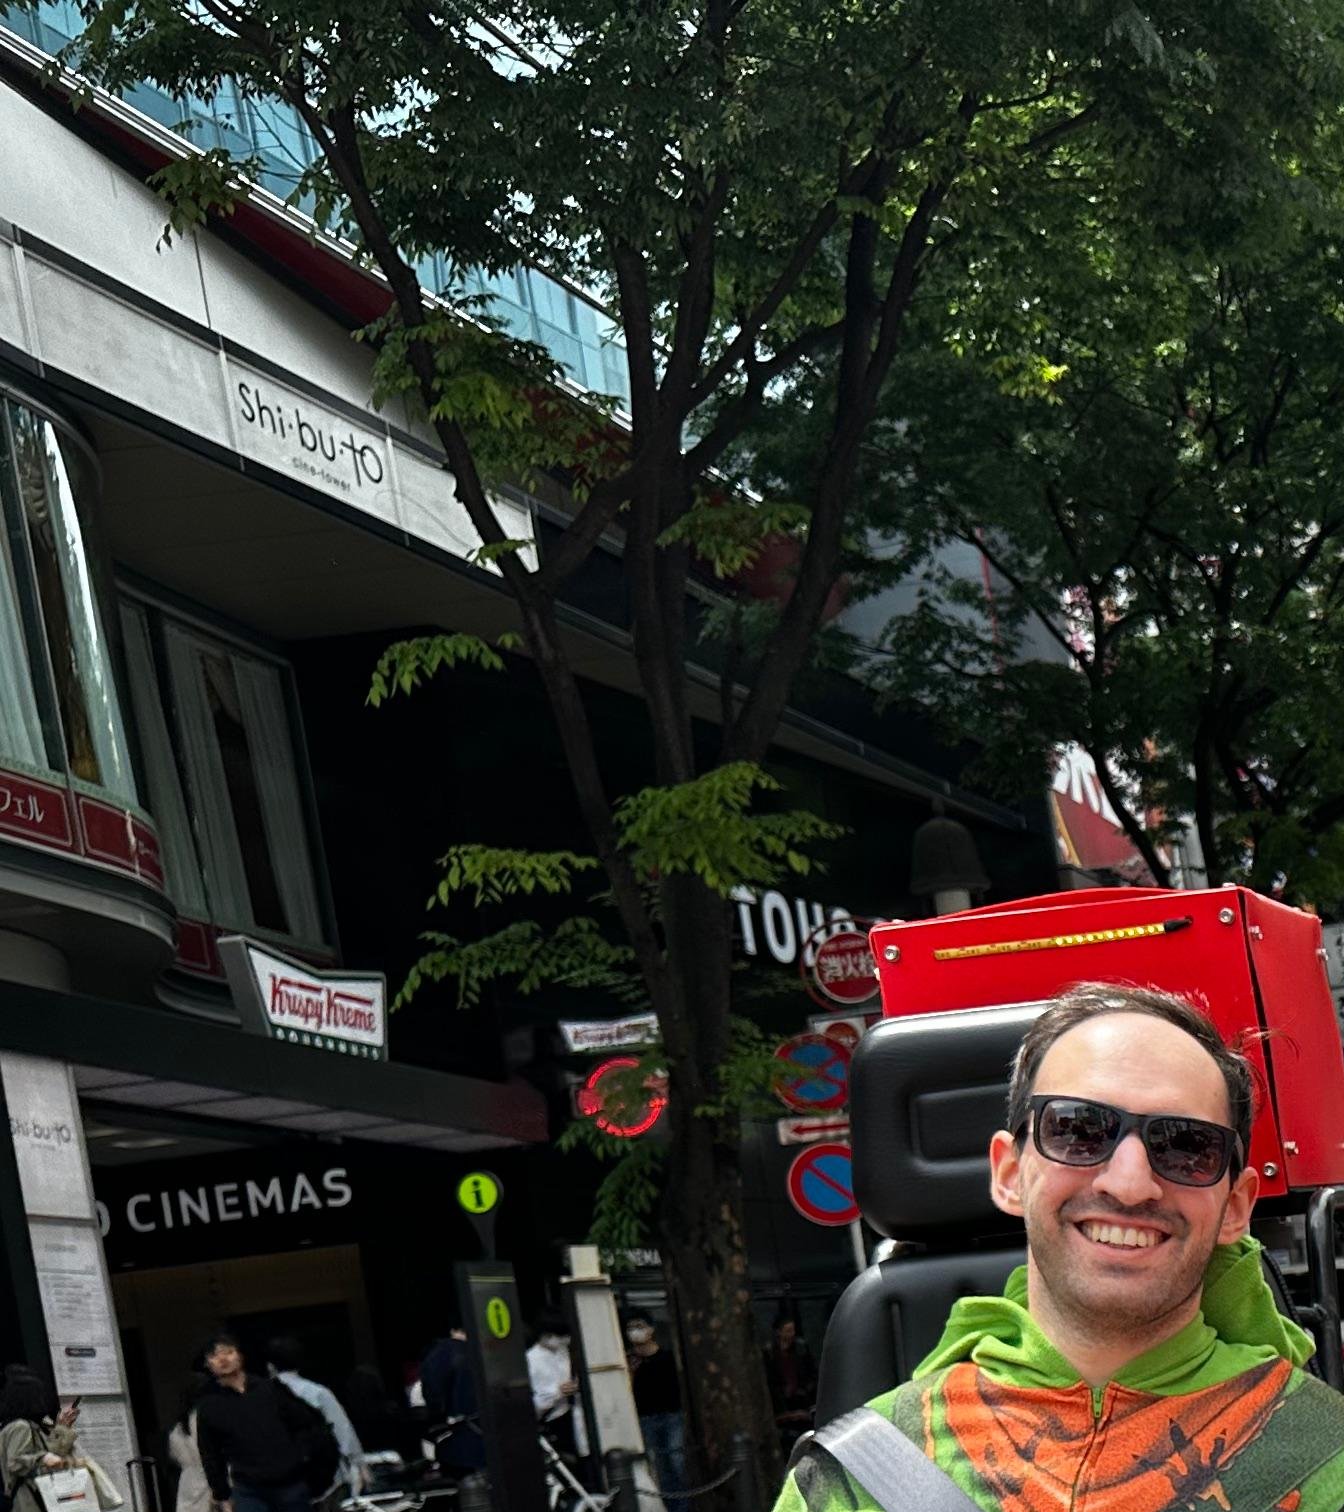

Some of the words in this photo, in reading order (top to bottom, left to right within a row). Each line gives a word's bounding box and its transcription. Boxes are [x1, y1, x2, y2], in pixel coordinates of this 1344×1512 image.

[269, 972, 323, 1031] Krispy
[324, 986, 377, 1034] Kreme
[126, 1168, 352, 1233] CINEMAS
